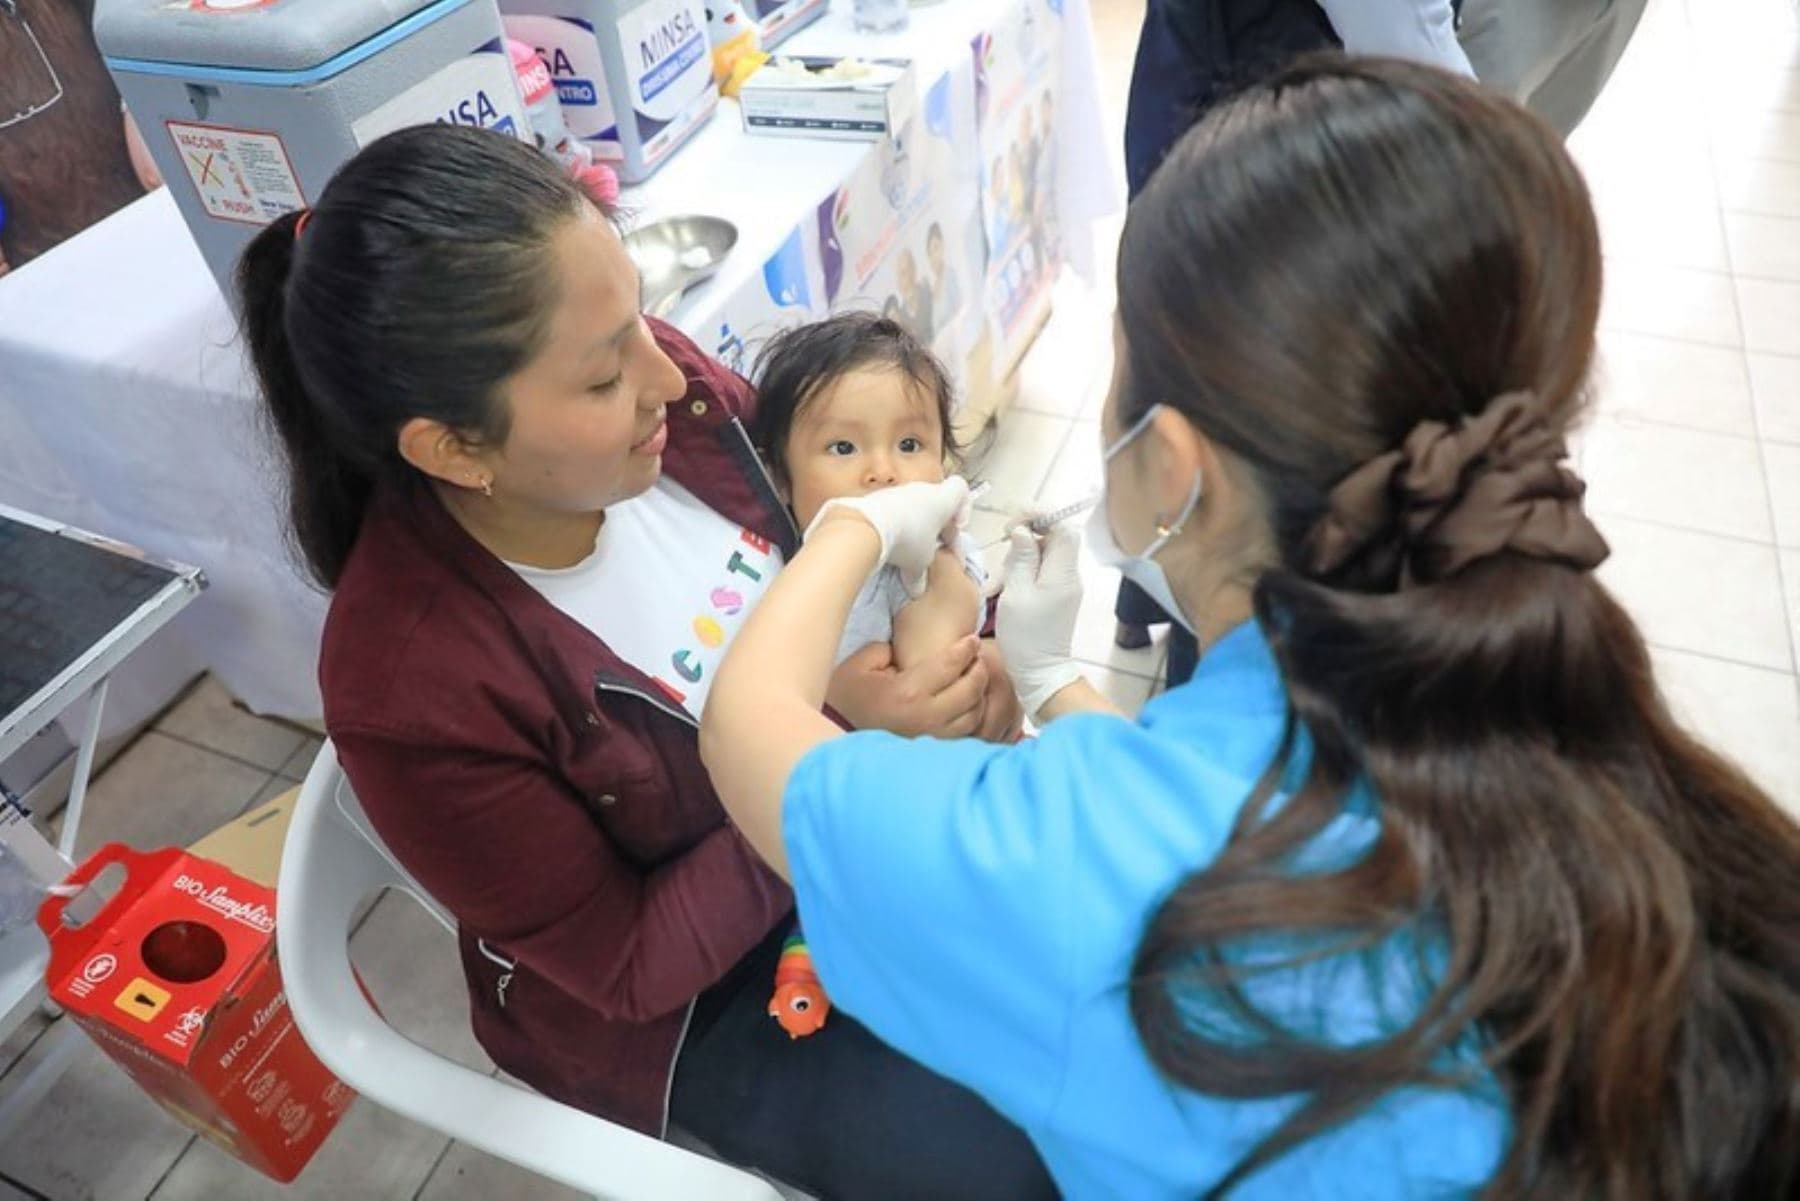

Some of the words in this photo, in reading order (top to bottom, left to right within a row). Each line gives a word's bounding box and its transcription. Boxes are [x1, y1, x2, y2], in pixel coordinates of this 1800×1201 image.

[641, 9, 697, 69] MINSA
[535, 47, 576, 76] SA
[559, 86, 593, 101] NTRO
[653, 528, 771, 704] COSTE
[173, 875, 204, 895] BIO
[219, 1034, 249, 1069] BIO
